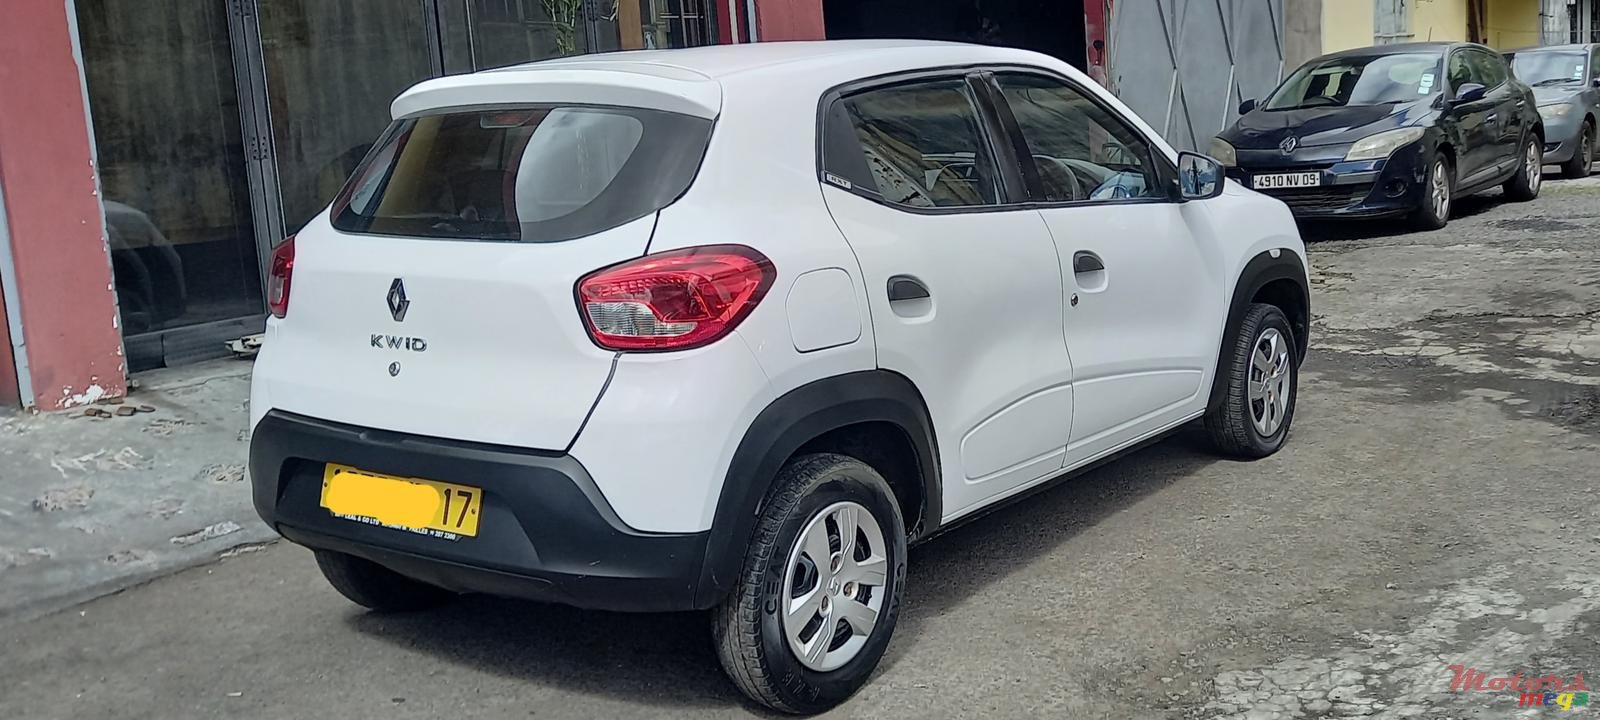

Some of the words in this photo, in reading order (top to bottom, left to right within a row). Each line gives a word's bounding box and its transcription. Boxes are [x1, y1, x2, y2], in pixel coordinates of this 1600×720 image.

[1258, 175, 1284, 187] 4910
[1286, 174, 1300, 186] NV
[1302, 174, 1316, 186] 09
[370, 333, 428, 353] KWID
[442, 487, 473, 528] 17
